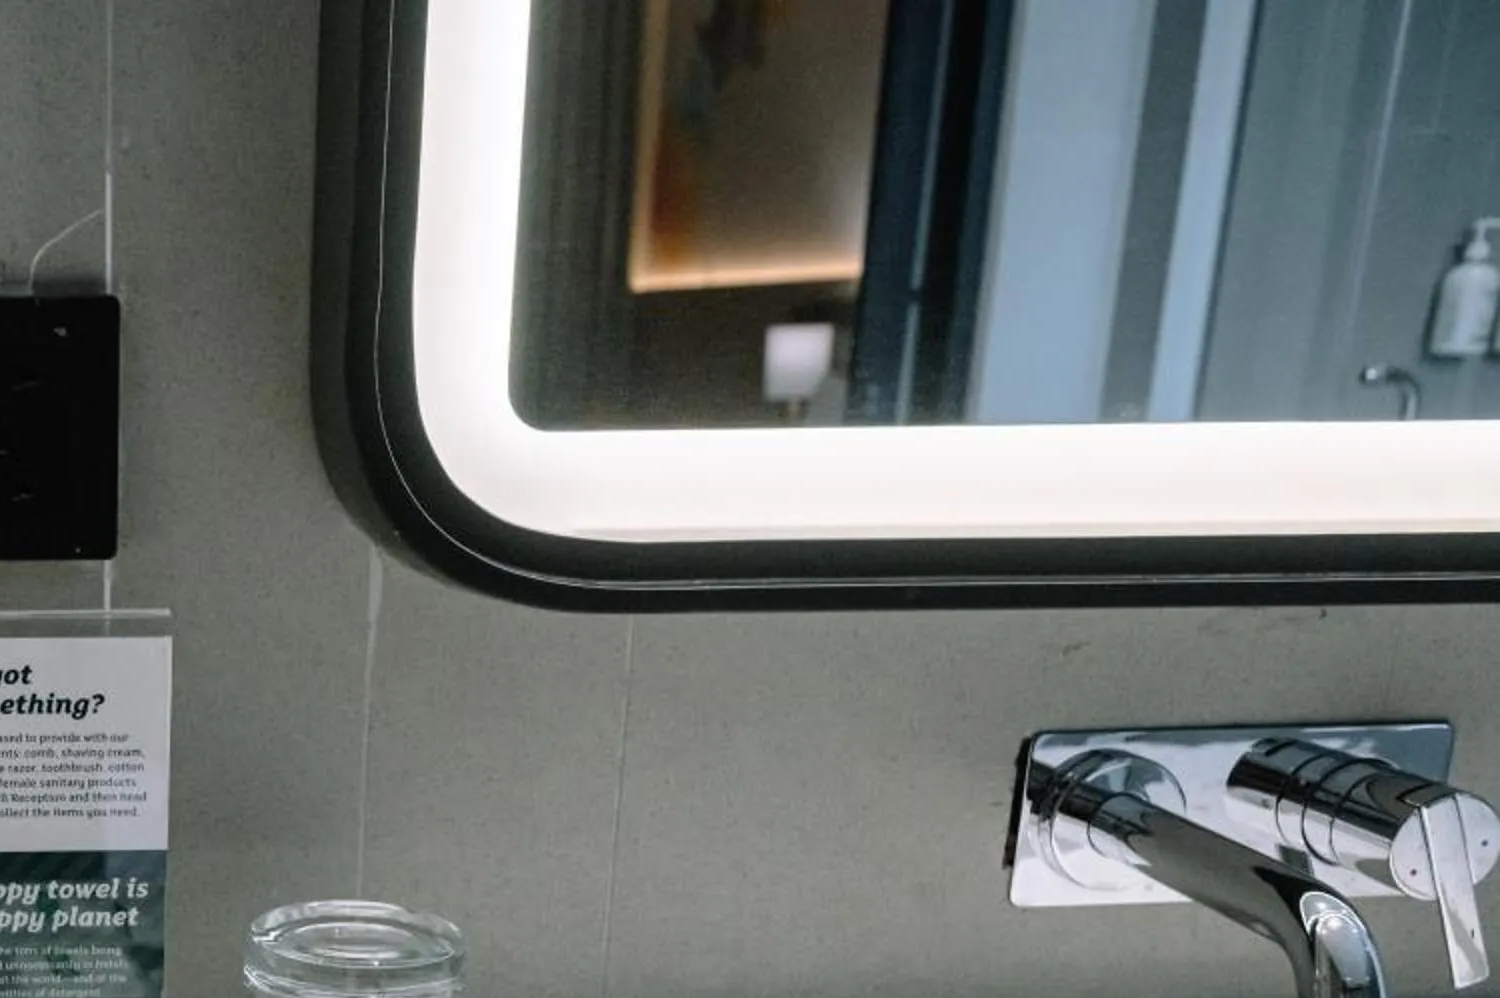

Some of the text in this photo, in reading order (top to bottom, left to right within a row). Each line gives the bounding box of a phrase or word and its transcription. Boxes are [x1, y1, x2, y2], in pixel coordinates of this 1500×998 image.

[25, 732, 37, 744] to
[39, 731, 81, 746] provide
[83, 731, 108, 743] with
[61, 747, 105, 760] shaving
[107, 763, 145, 773] cotton
[39, 778, 85, 791] sanitary
[11, 793, 67, 804] Reception
[69, 792, 89, 803] and
[91, 792, 117, 802] then
[119, 791, 148, 802] head
[31, 807, 50, 818] the
[52, 807, 85, 818] items
[86, 808, 107, 820] you
[47, 877, 120, 901] towel
[126, 877, 150, 899] is
[50, 905, 141, 934] planet
